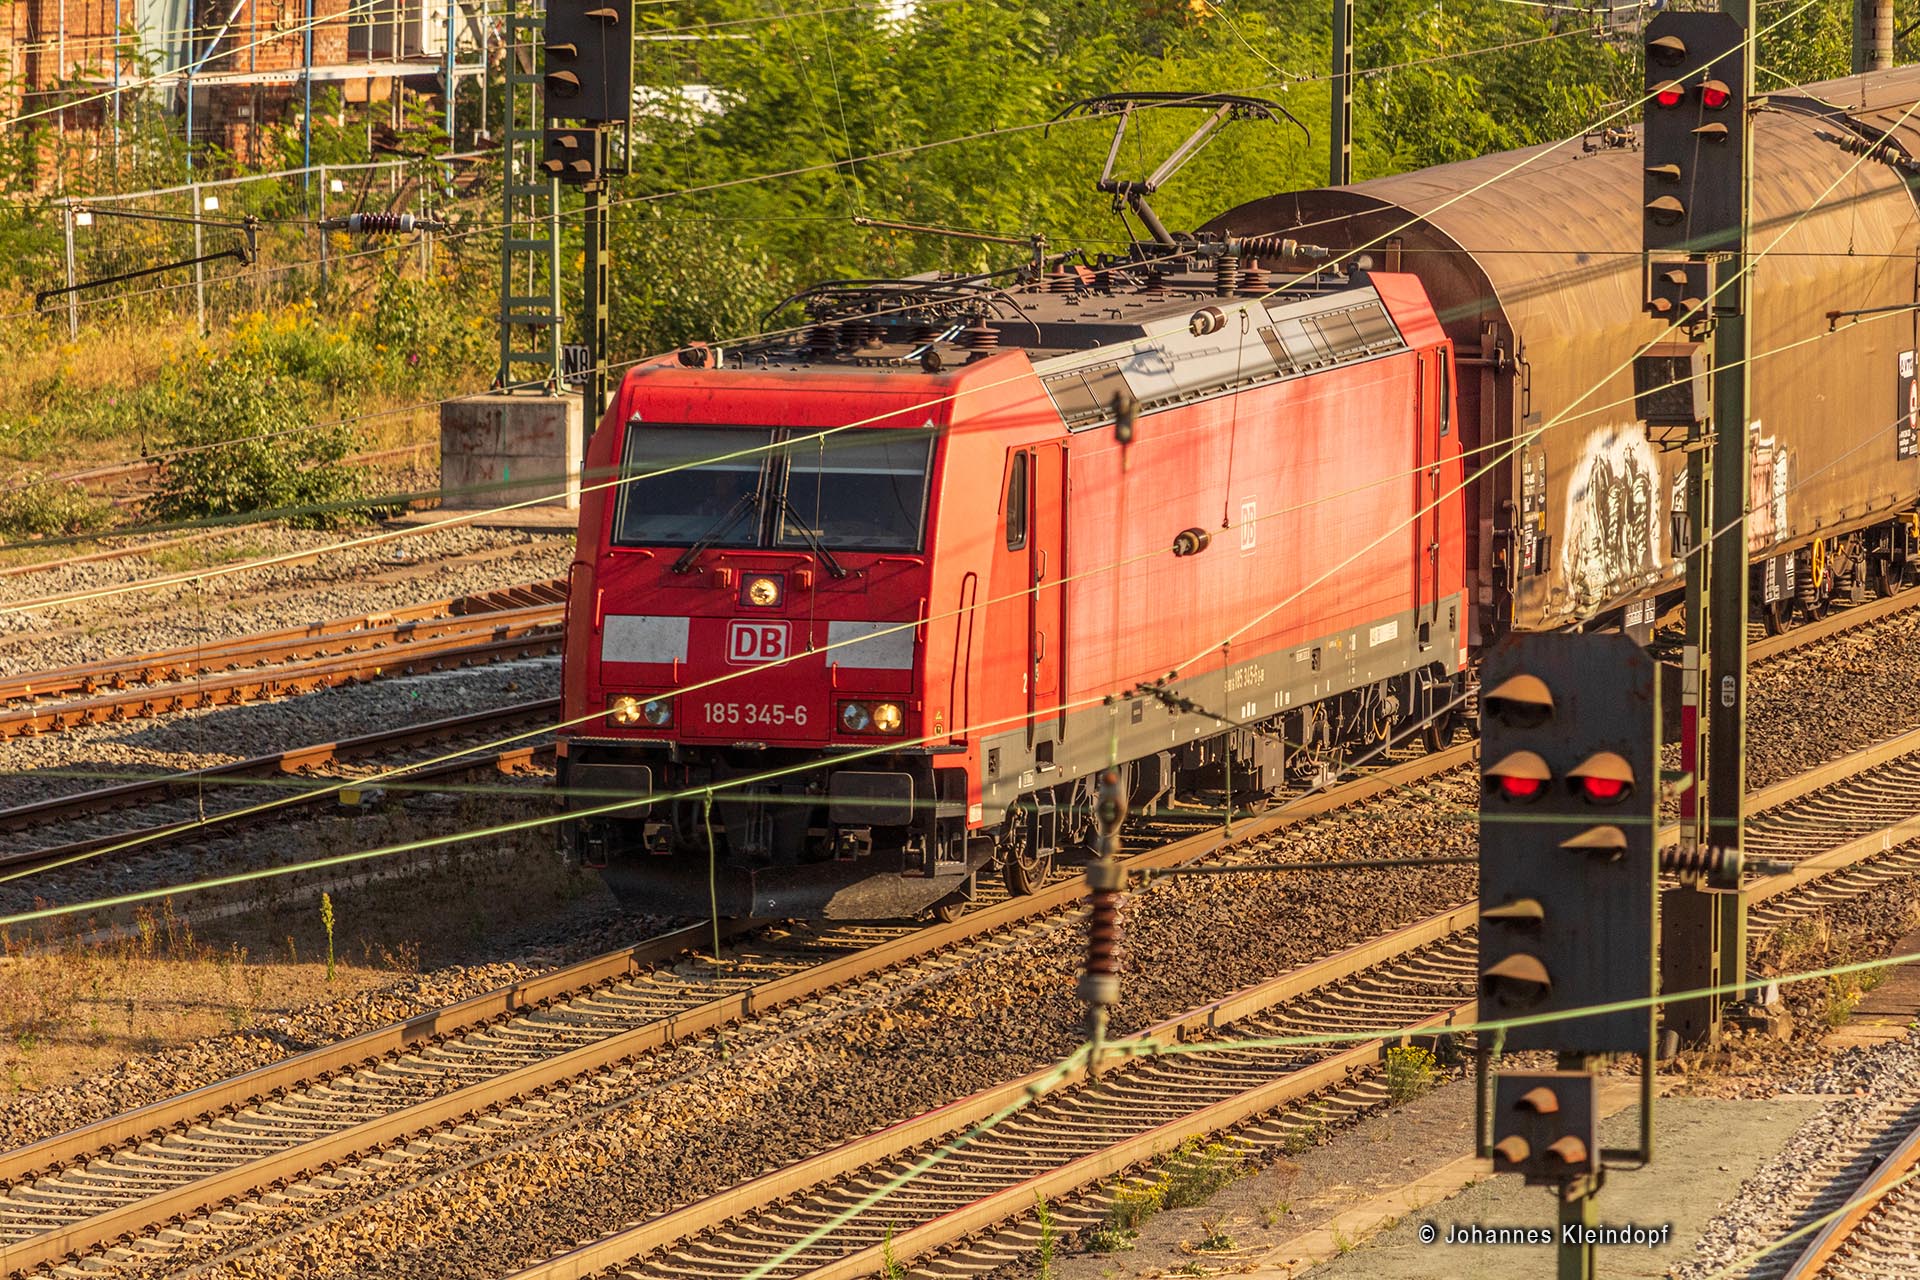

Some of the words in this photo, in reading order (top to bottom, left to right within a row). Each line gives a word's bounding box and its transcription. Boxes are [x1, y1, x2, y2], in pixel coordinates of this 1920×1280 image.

[564, 347, 588, 381] N8
[1242, 503, 1256, 549] DB
[1672, 516, 1689, 554] N4
[733, 625, 784, 659] DB
[1022, 672, 1028, 694] 2
[704, 702, 740, 724] 185
[744, 703, 808, 726] 345-6
